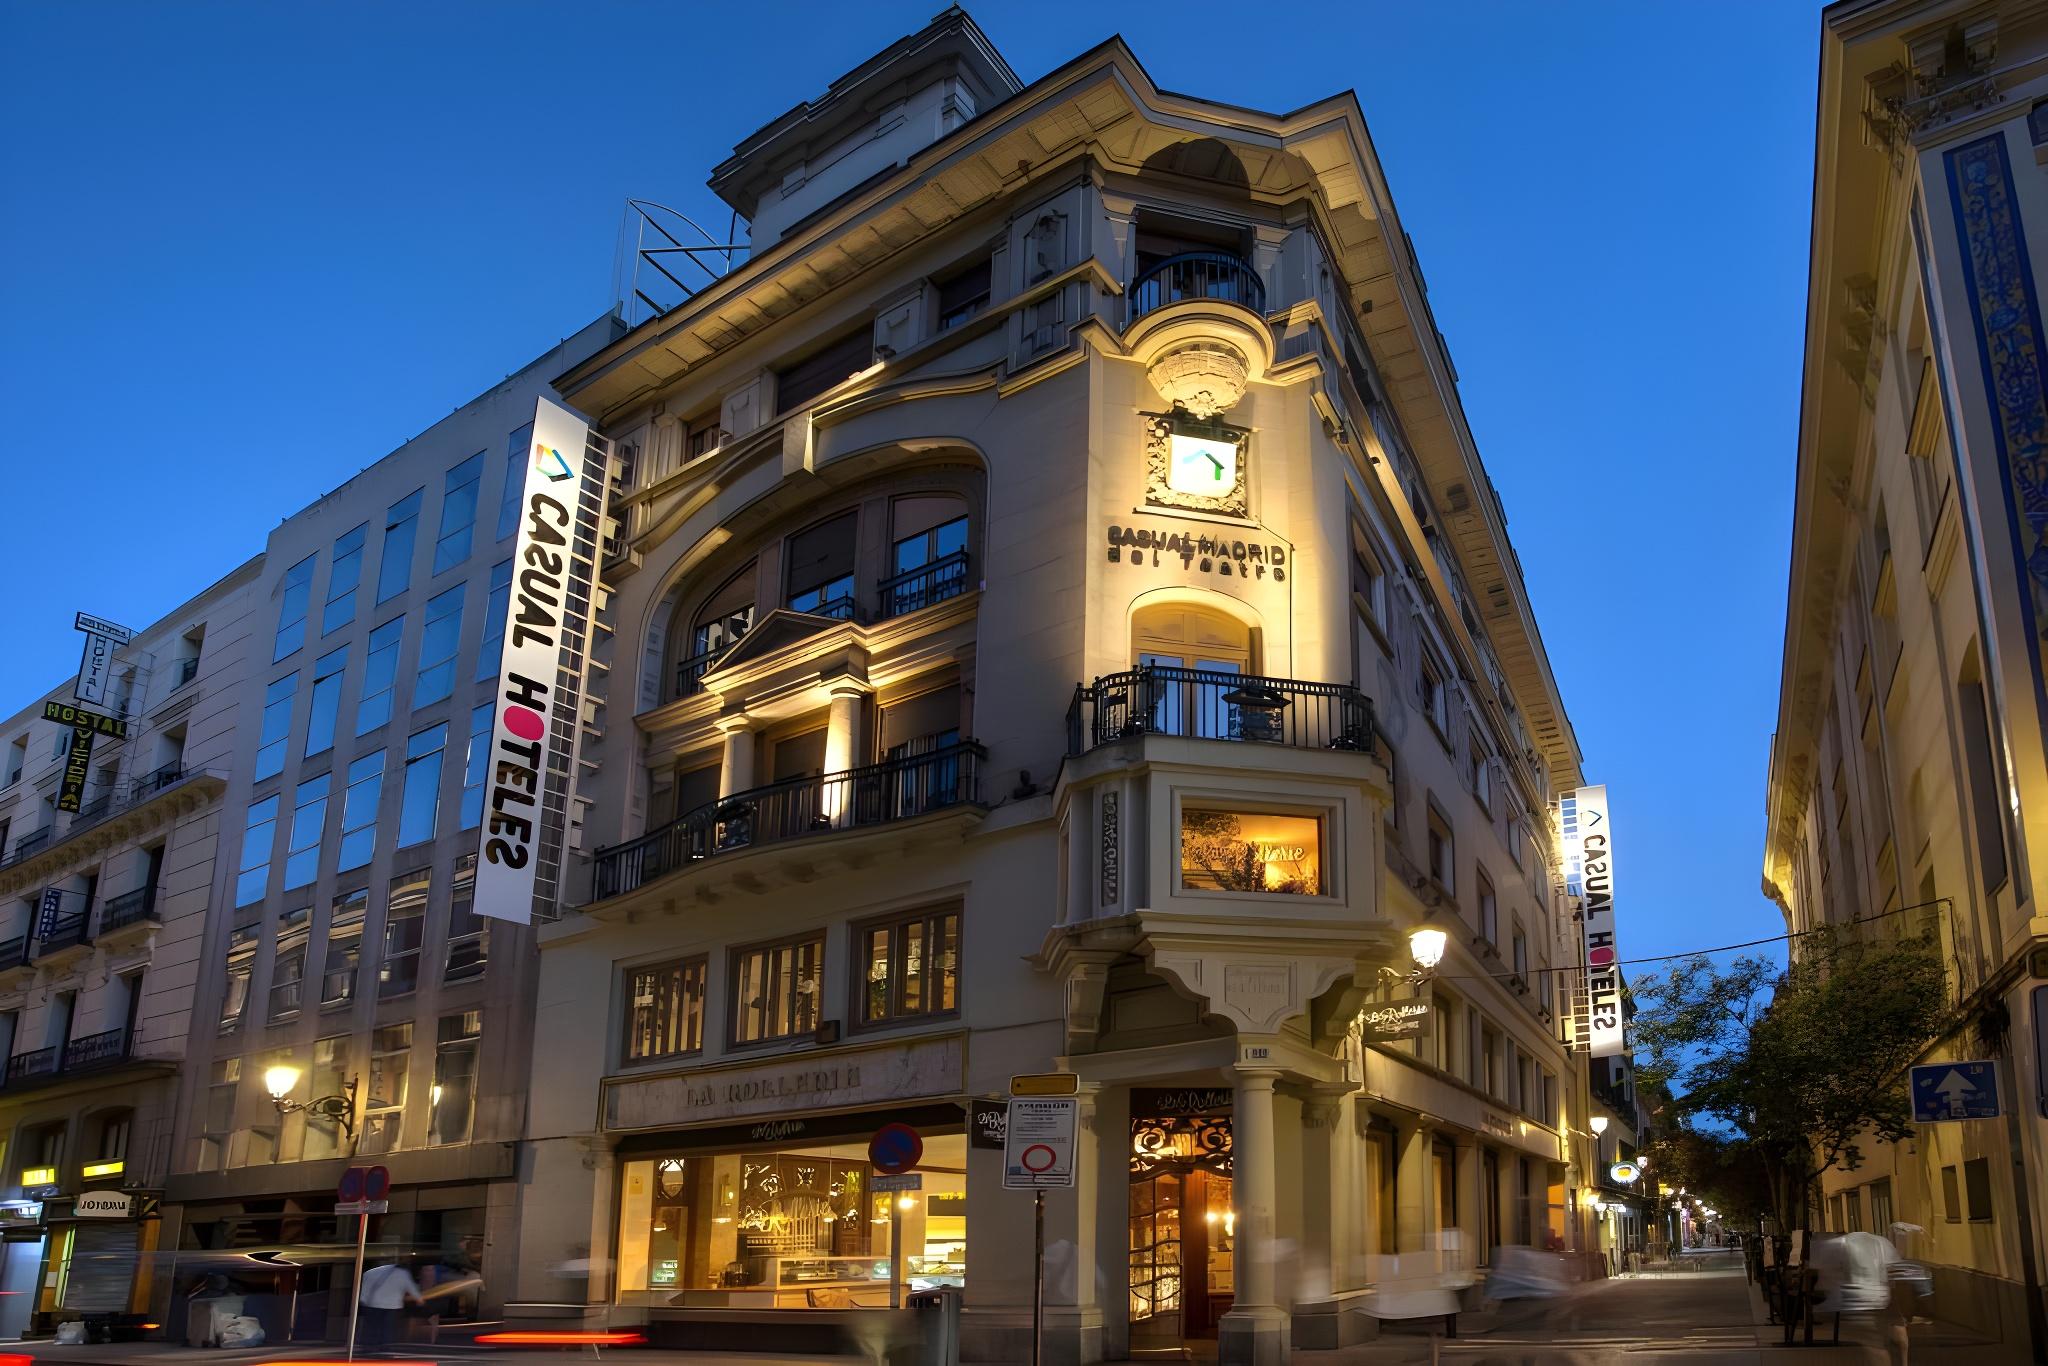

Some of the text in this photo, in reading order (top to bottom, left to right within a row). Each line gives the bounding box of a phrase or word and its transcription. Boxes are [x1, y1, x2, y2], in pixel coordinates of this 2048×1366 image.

[47, 702, 127, 739] HOSTAL
[486, 492, 570, 871] CASUAL HOTELES
[1584, 834, 1617, 1031] CASUAL HOTELES
